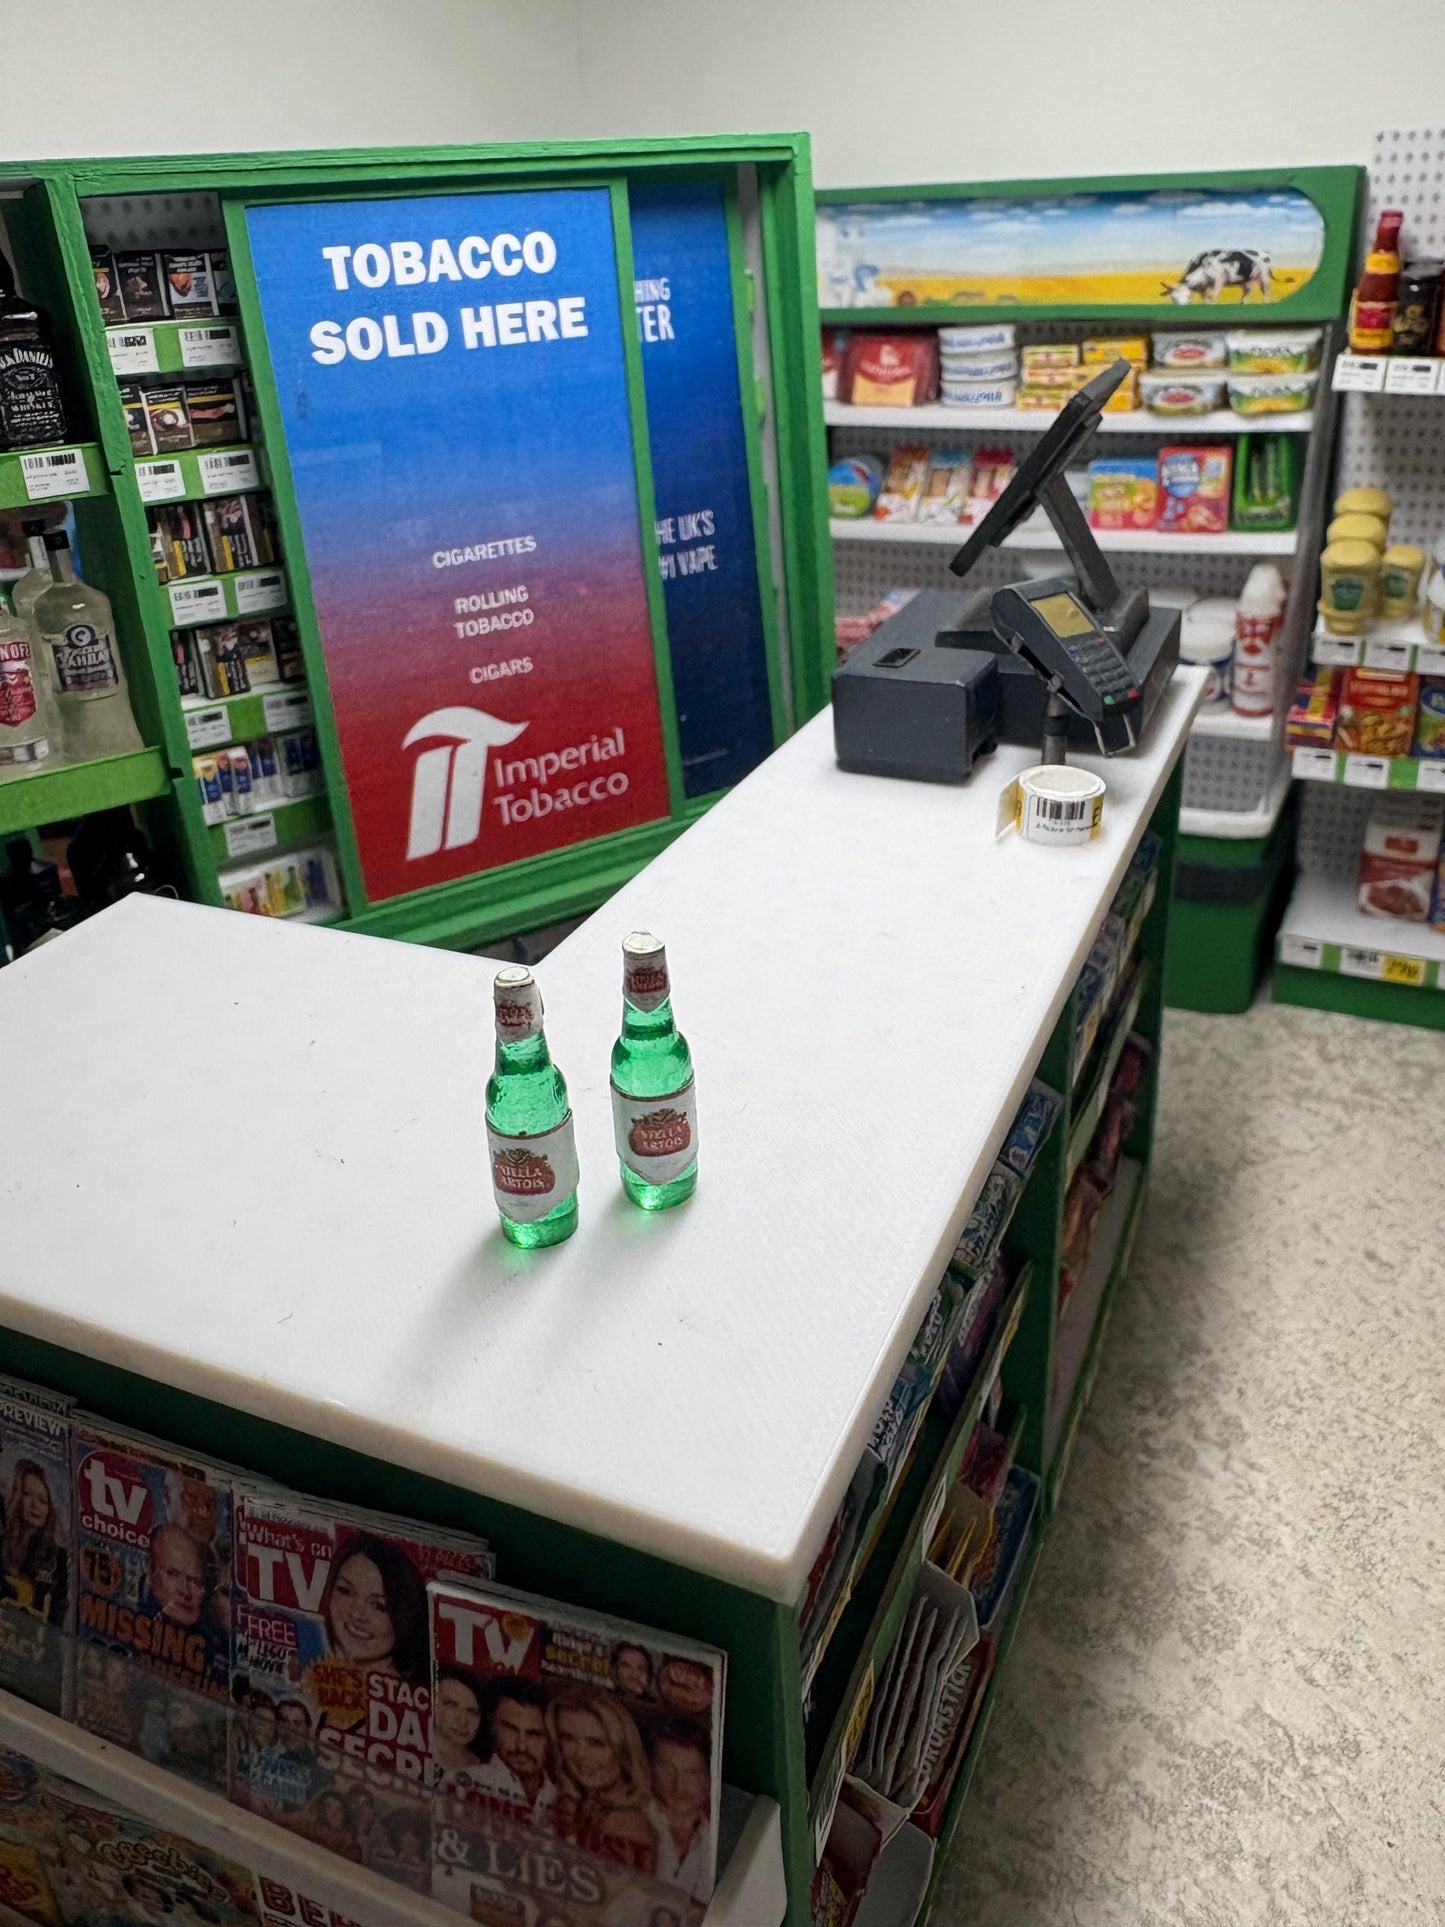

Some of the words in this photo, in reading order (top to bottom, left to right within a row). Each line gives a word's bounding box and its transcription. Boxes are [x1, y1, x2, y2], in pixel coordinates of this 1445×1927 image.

[322, 231, 558, 291] TOBACCO
[309, 311, 449, 365] SOLD
[461, 296, 590, 350] HERE
[432, 535, 537, 569] CIGARETTES
[676, 544, 719, 576] VAPE
[453, 608, 535, 639] TOBACCO
[454, 584, 529, 615] ROLLING
[468, 656, 535, 684] CIGARS
[493, 726, 626, 788] Imperial
[494, 771, 630, 826] Tobacco
[84, 1458, 147, 1526] tv
[81, 1513, 151, 1549] choice
[247, 1541, 331, 1613] TV
[79, 1593, 206, 1675] MISSING
[247, 1614, 298, 1647] FREE
[438, 1601, 535, 1676] TV
[438, 1826, 470, 1868] &
